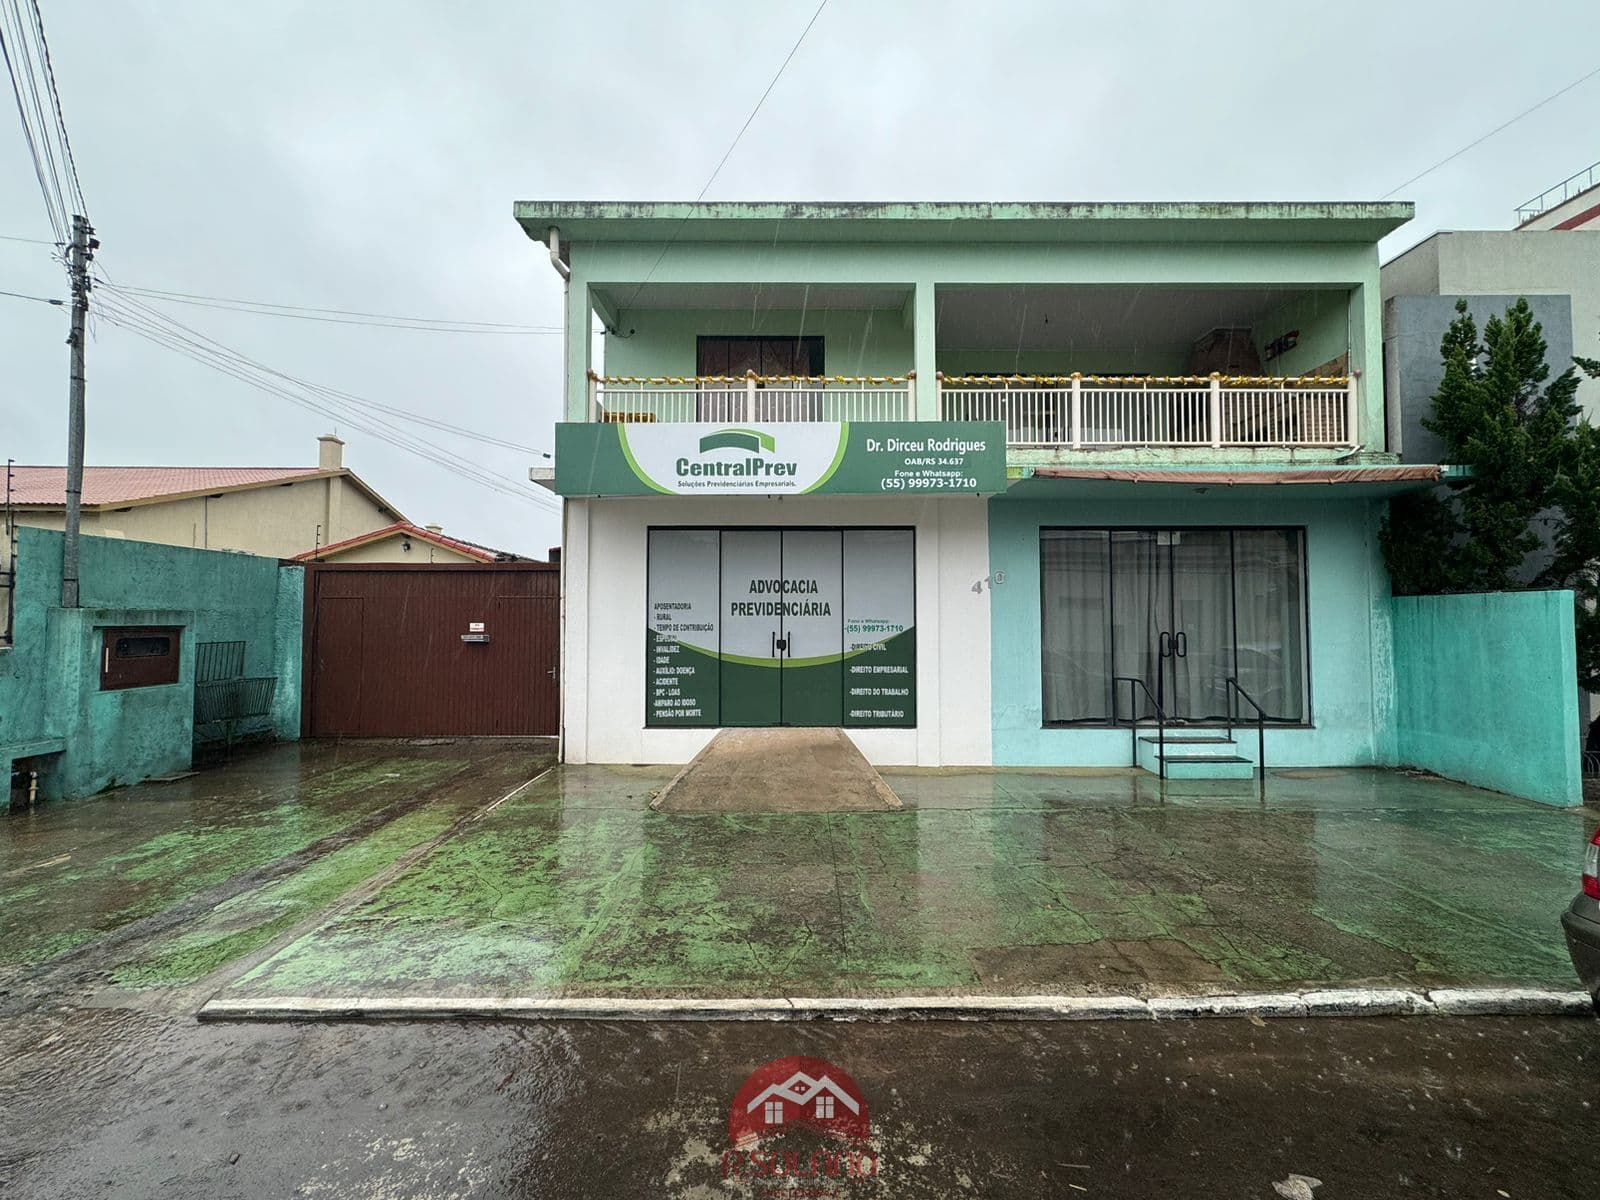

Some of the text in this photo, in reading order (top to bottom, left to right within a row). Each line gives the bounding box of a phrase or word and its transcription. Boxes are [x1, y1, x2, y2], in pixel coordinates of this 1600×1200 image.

[866, 437, 986, 455] Dr. Dirceu Rodrigues
[904, 458, 936, 466] OAB/RS
[676, 458, 797, 476] CentralPrev
[922, 470, 963, 479] Whatsapp:
[881, 478, 977, 489] (55) 99973-1710
[749, 579, 818, 594] ADVOCACIA
[971, 570, 1006, 594] 410
[731, 598, 832, 616] PREVIDENCIÁRIA
[656, 623, 672, 631] TEMPO
[673, 623, 679, 631] DE
[862, 624, 904, 632] 99973-1710
[873, 665, 909, 673] EMPRESARIAL
[656, 677, 678, 685] ACIDENTE
[873, 688, 881, 696] DO
[881, 688, 909, 696] TRABALHO
